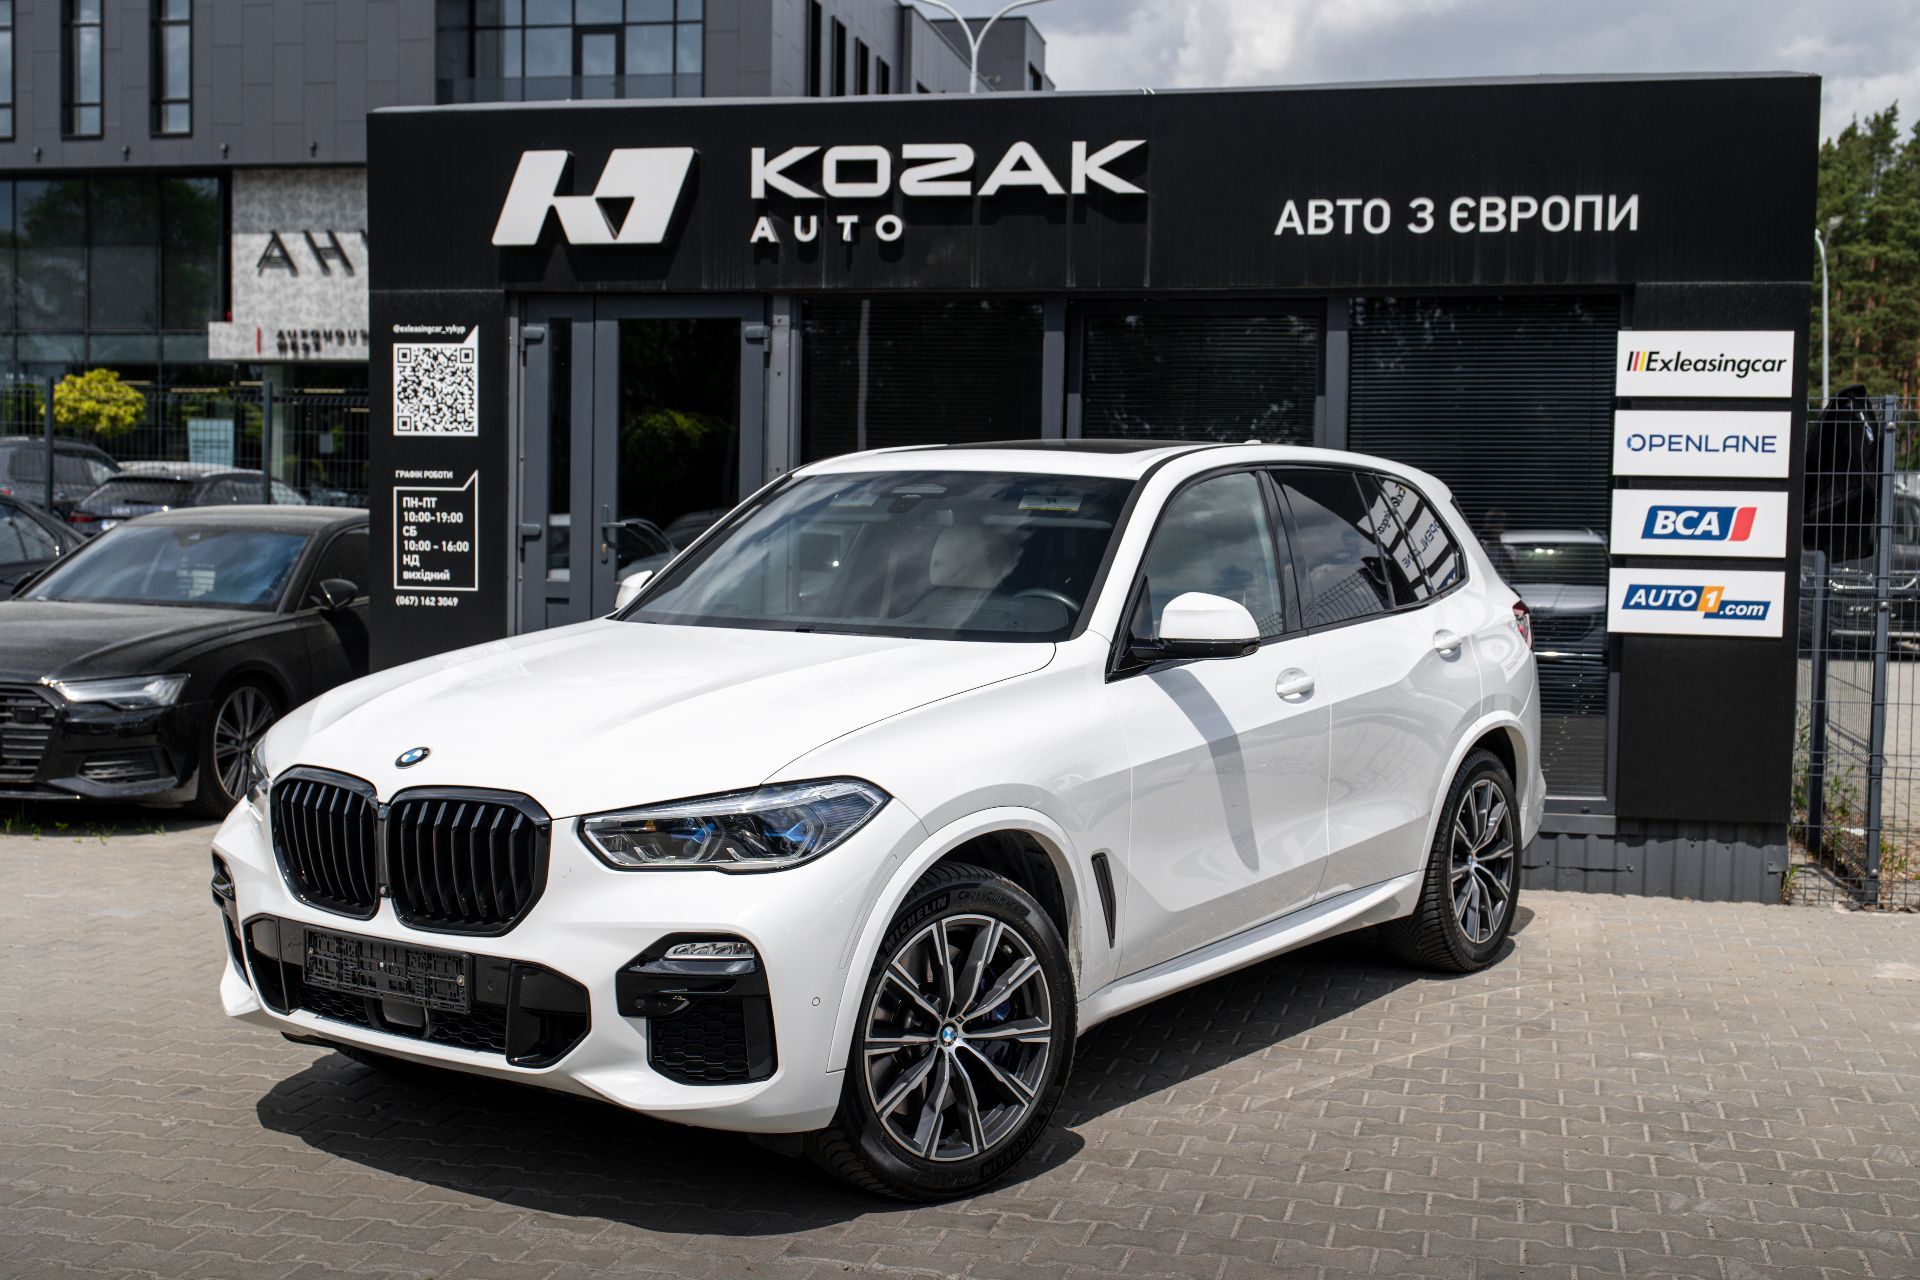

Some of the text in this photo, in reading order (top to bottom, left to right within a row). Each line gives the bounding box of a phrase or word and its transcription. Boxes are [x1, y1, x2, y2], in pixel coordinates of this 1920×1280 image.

[751, 140, 1147, 199] KOZAK
[1274, 193, 1640, 236] АВТО З ЄВРОПИ
[750, 214, 904, 243] AUTO
[1645, 350, 1787, 379] Exleasingcar
[1626, 433, 1777, 453] OPENLANE
[395, 470, 454, 480] ГРАФІК РОБОТИ
[402, 496, 438, 508] ПН-ПТ
[403, 511, 464, 524] 10:00-19:00
[1652, 509, 1721, 537] BCA
[402, 525, 418, 537] СБ
[403, 540, 432, 552] 10:00
[442, 541, 470, 552] 16:00
[402, 554, 421, 567] НД
[402, 568, 451, 582] вихідний
[395, 595, 459, 607] (067) 162 3049
[884, 895, 948, 952] MICHELIN
